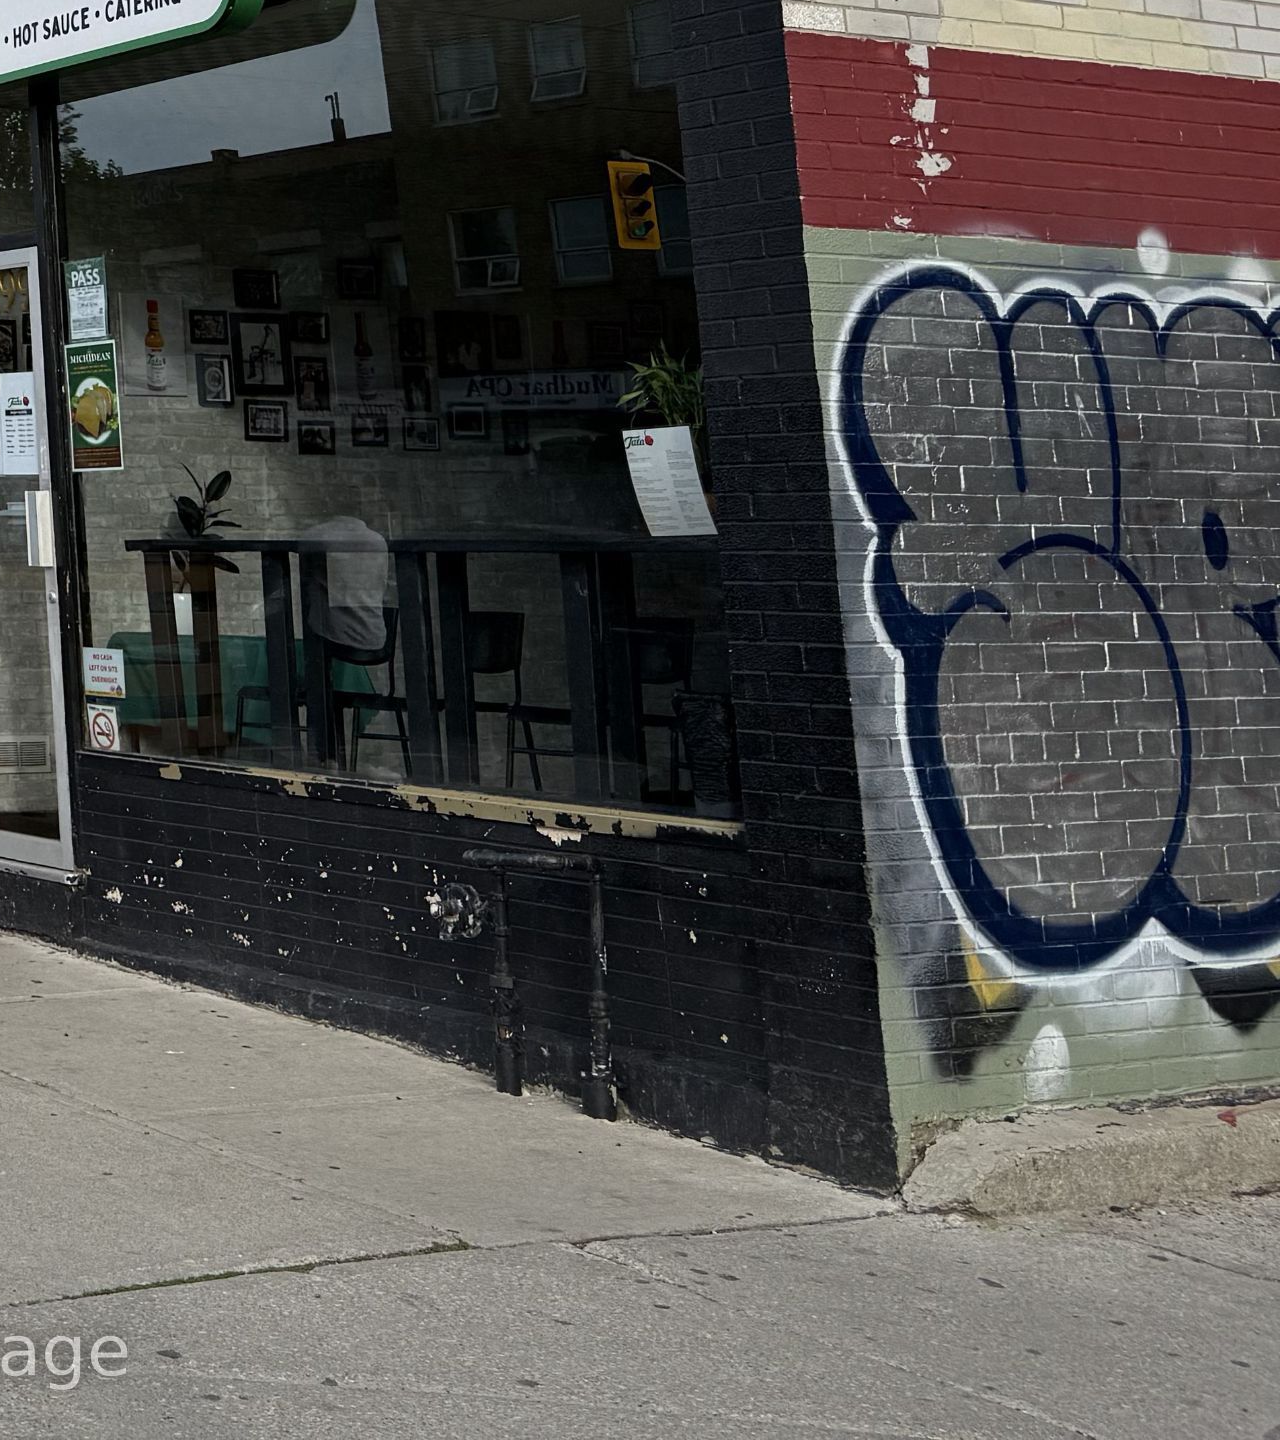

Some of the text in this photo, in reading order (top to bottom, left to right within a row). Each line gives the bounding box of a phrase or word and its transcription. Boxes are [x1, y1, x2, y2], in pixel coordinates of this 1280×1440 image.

[13, 21, 39, 49] HOT
[42, 7, 90, 39] SAUCE
[71, 268, 100, 287] PASS
